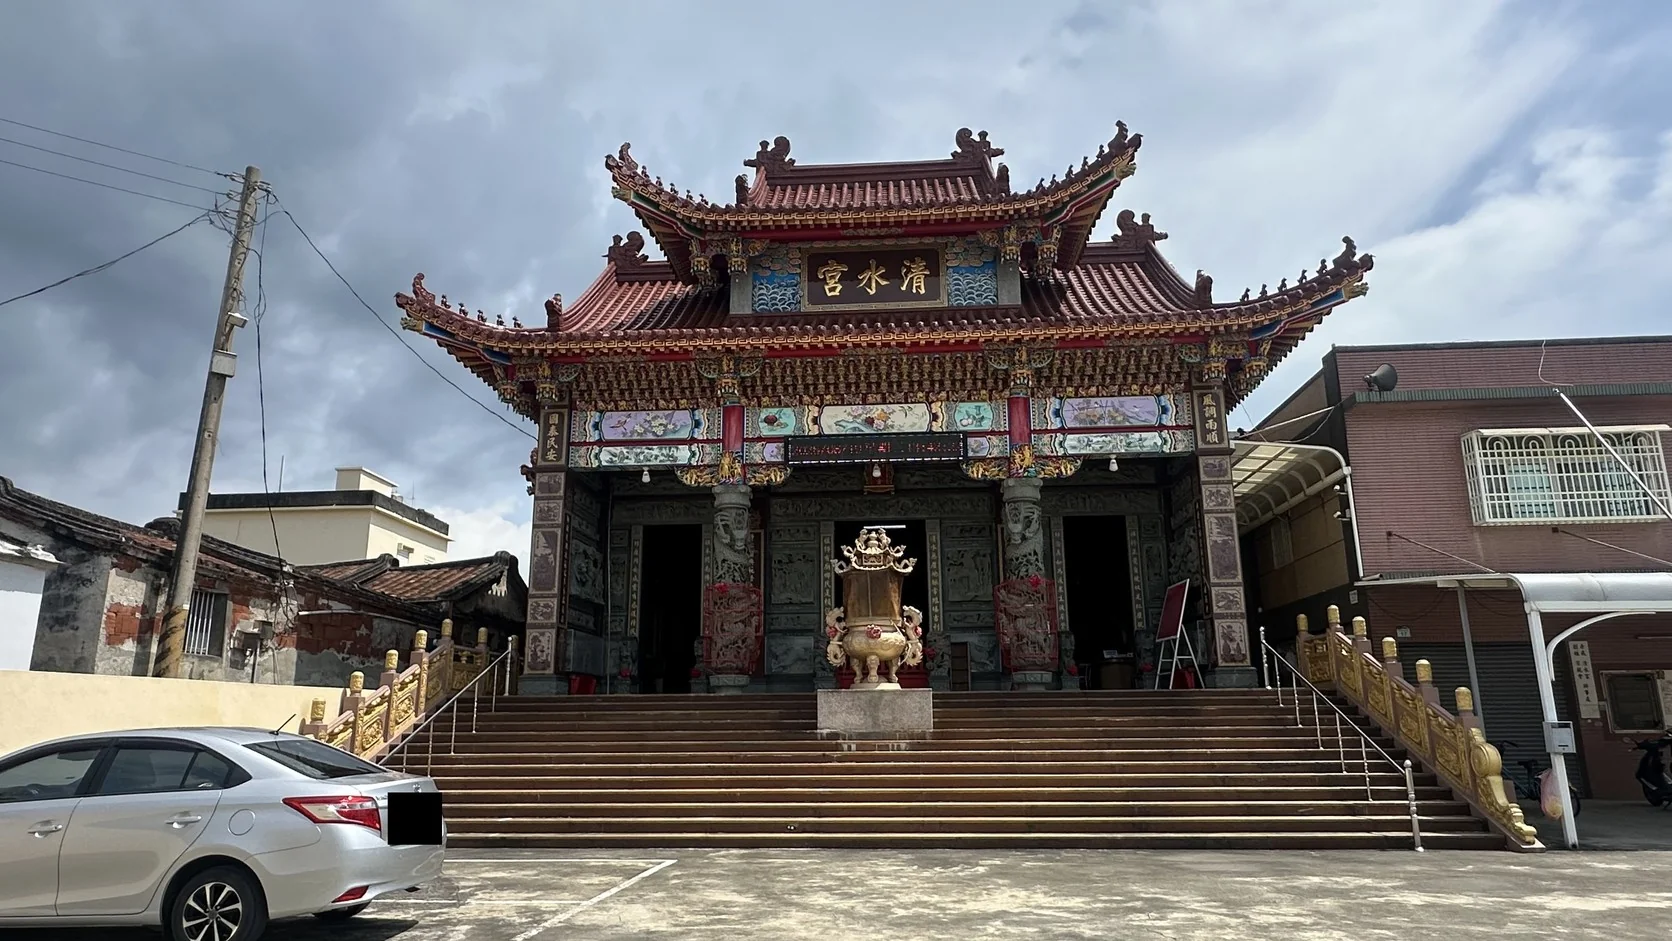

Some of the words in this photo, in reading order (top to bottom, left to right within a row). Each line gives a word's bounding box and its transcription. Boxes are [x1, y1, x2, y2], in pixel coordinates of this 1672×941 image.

[817, 257, 930, 297] 清水宮
[545, 412, 560, 461] 國泰民安
[1202, 393, 1219, 444] 風調雨順
